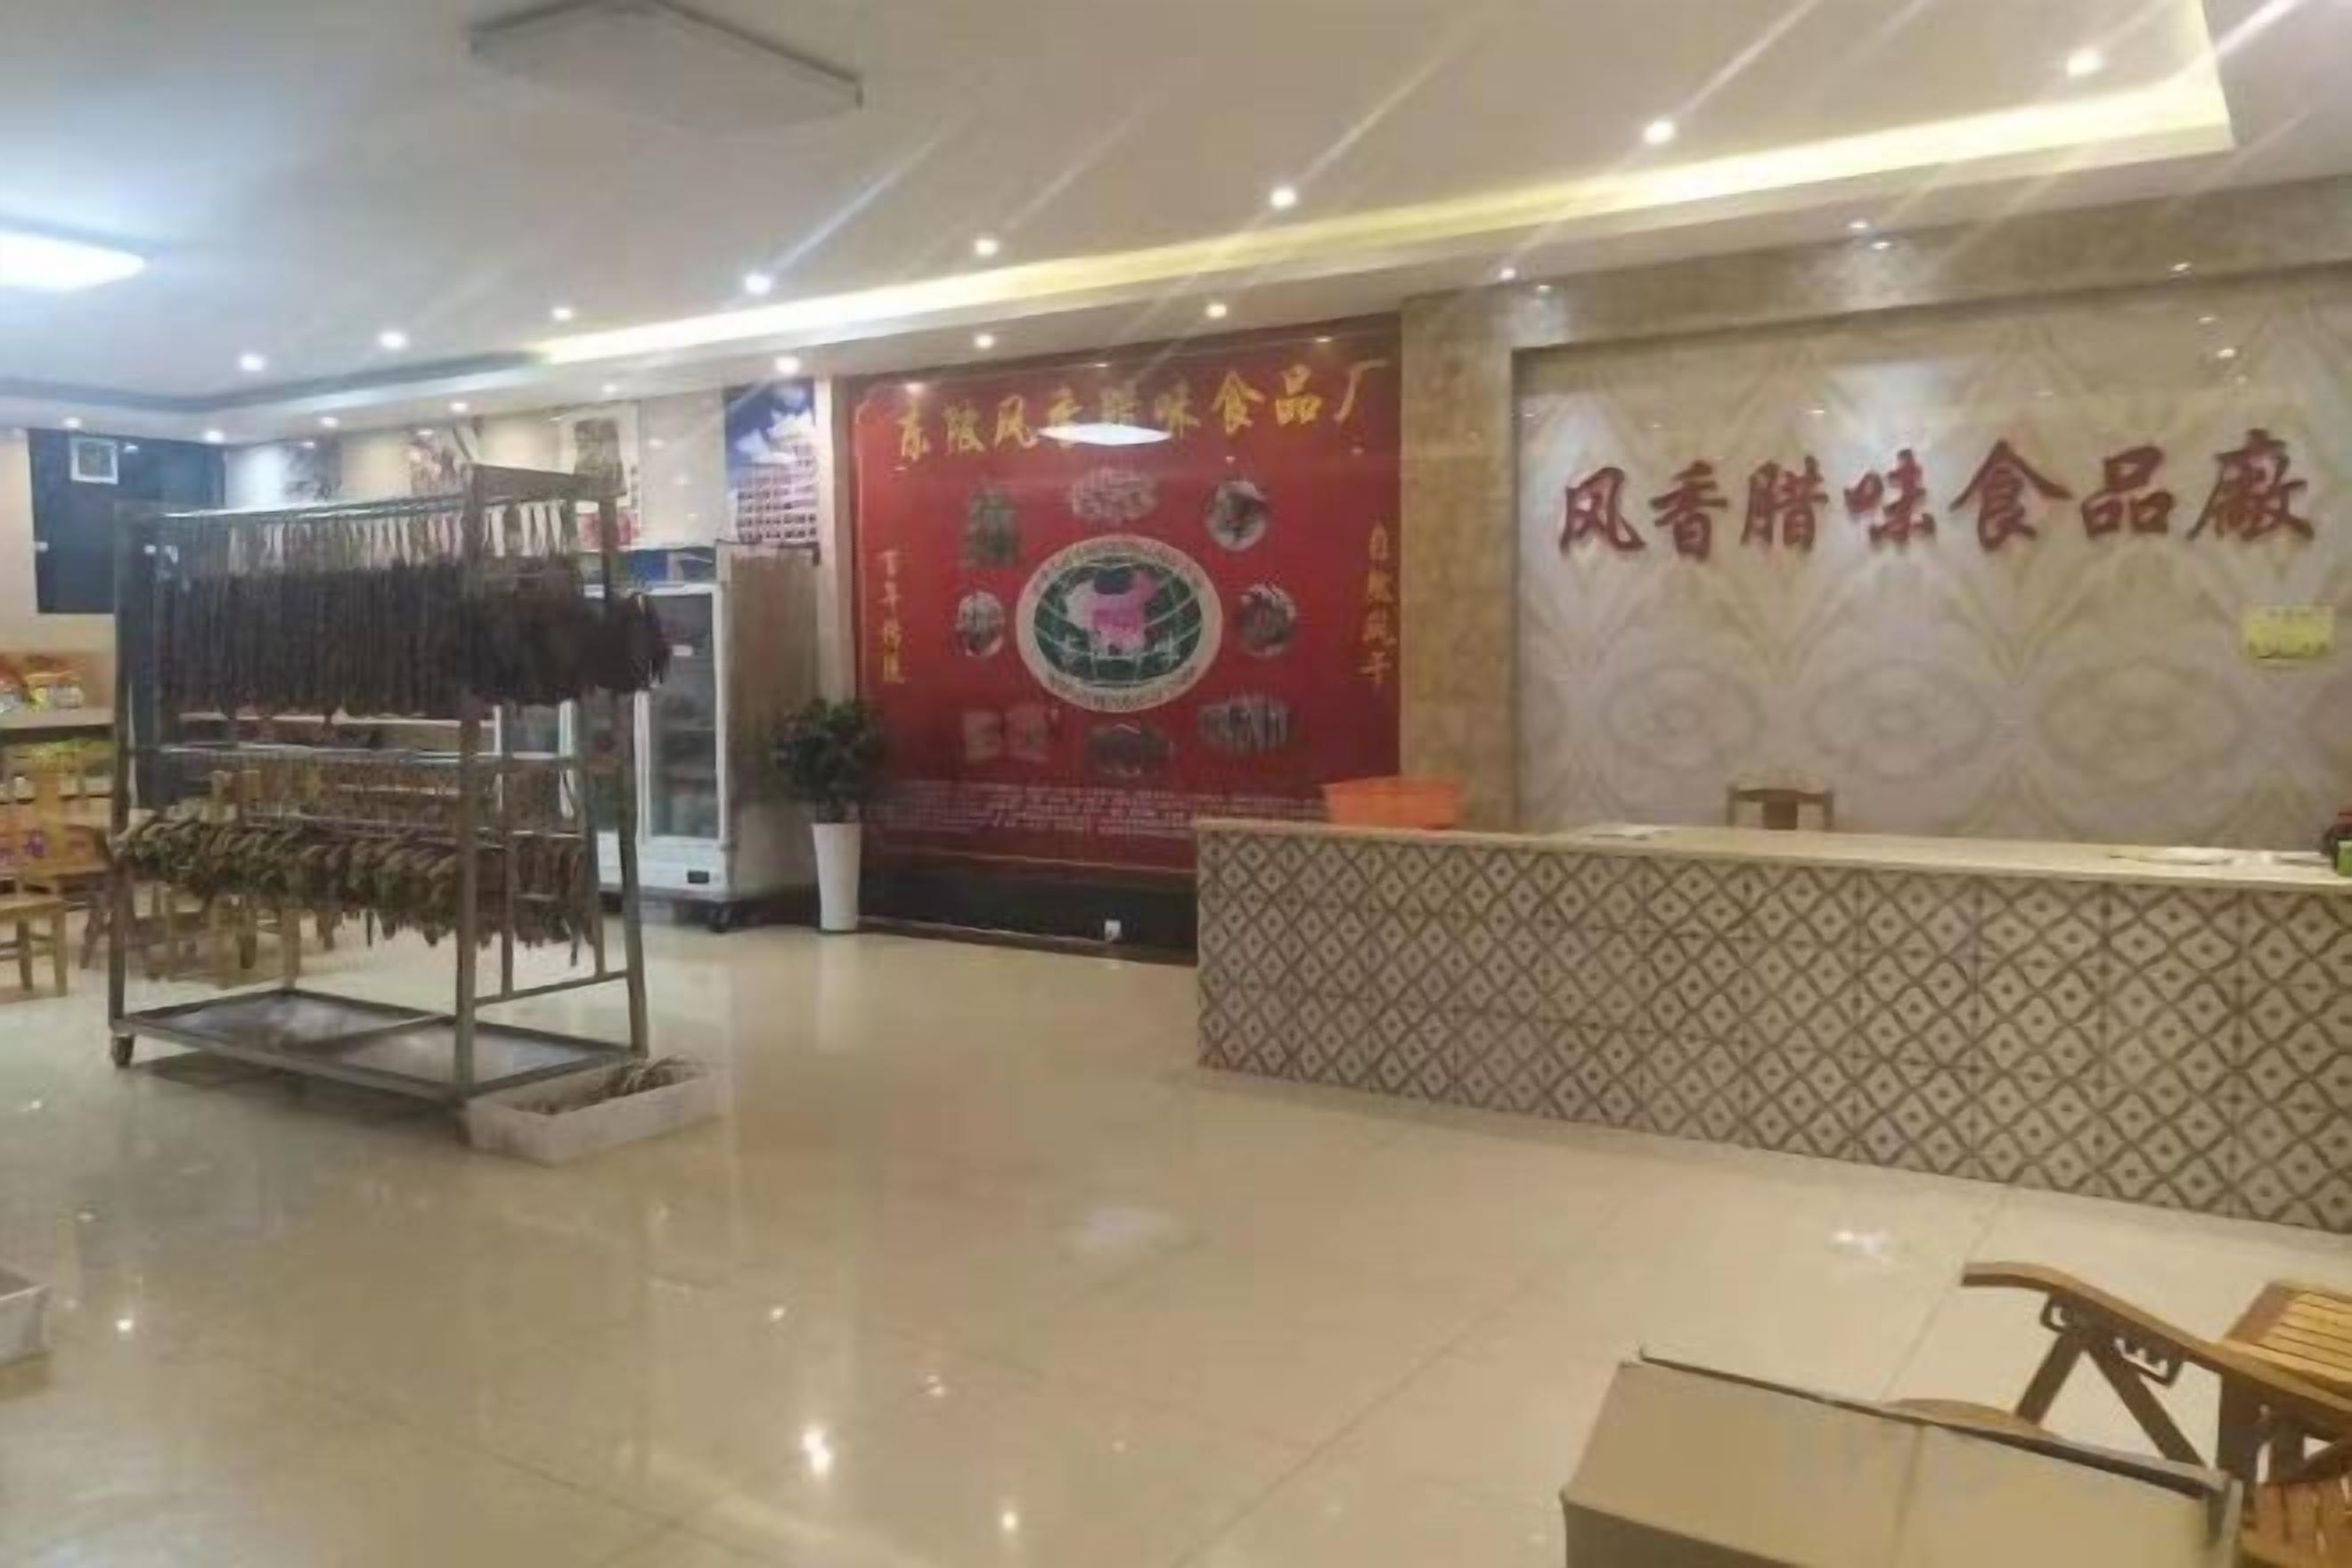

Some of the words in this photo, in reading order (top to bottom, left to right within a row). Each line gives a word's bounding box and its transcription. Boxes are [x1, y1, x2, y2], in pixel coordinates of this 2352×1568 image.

[1559, 428, 2315, 562] 风香腊味食品廠
